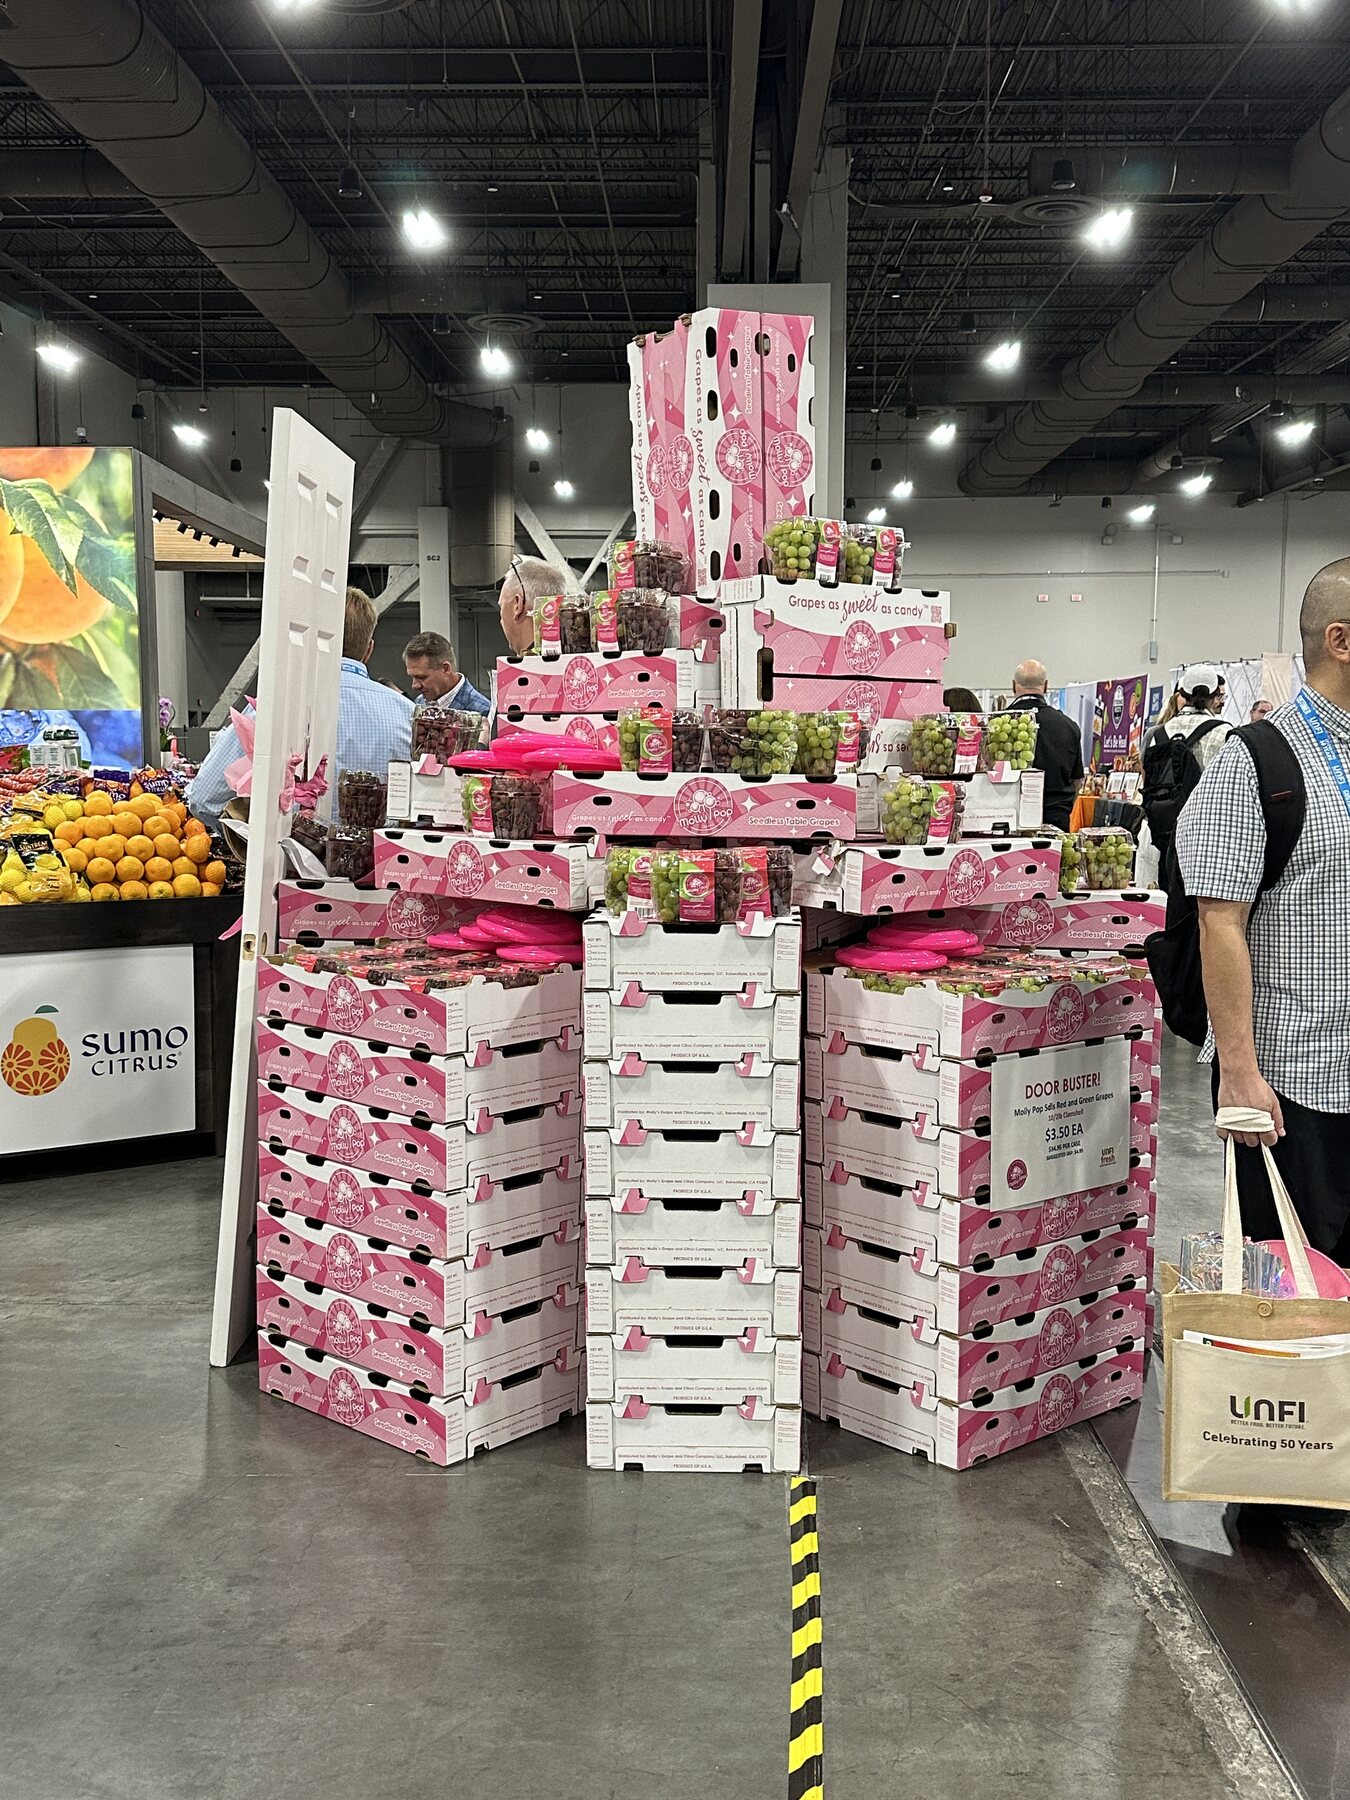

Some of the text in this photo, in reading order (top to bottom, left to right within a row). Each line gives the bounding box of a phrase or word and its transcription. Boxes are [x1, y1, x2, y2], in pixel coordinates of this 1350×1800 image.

[635, 384, 643, 428] candy
[696, 408, 702, 424] as
[638, 431, 643, 447] as
[691, 428, 711, 488] sweet
[632, 452, 650, 504] sweet
[698, 488, 704, 506] as
[640, 507, 646, 523] as
[788, 591, 923, 622] Grapes as sweet as candy
[608, 811, 634, 824] sweet
[748, 816, 840, 827] Seedless Table Grapes
[494, 880, 558, 895] Seedless Table Grapes
[1068, 930, 1100, 938] Seedless
[1100, 930, 1122, 939] Table
[374, 1018, 434, 1040] Seedless Table Grapes
[91, 1053, 178, 1076] CITRUS
[1026, 1072, 1100, 1100] DOOR BUSTER!
[1014, 1106, 1031, 1118] Molly
[1032, 1105, 1044, 1115] Pop
[1056, 1101, 1066, 1110] Red
[1068, 1099, 1078, 1108] and
[1078, 1096, 1094, 1106] Green
[1096, 1092, 1114, 1103] Grapes
[1046, 1122, 1084, 1143] $3.50 EA
[374, 1216, 436, 1242] Seedless Table Grapes
[1202, 1430, 1334, 1450] Celebrating 50 Years
